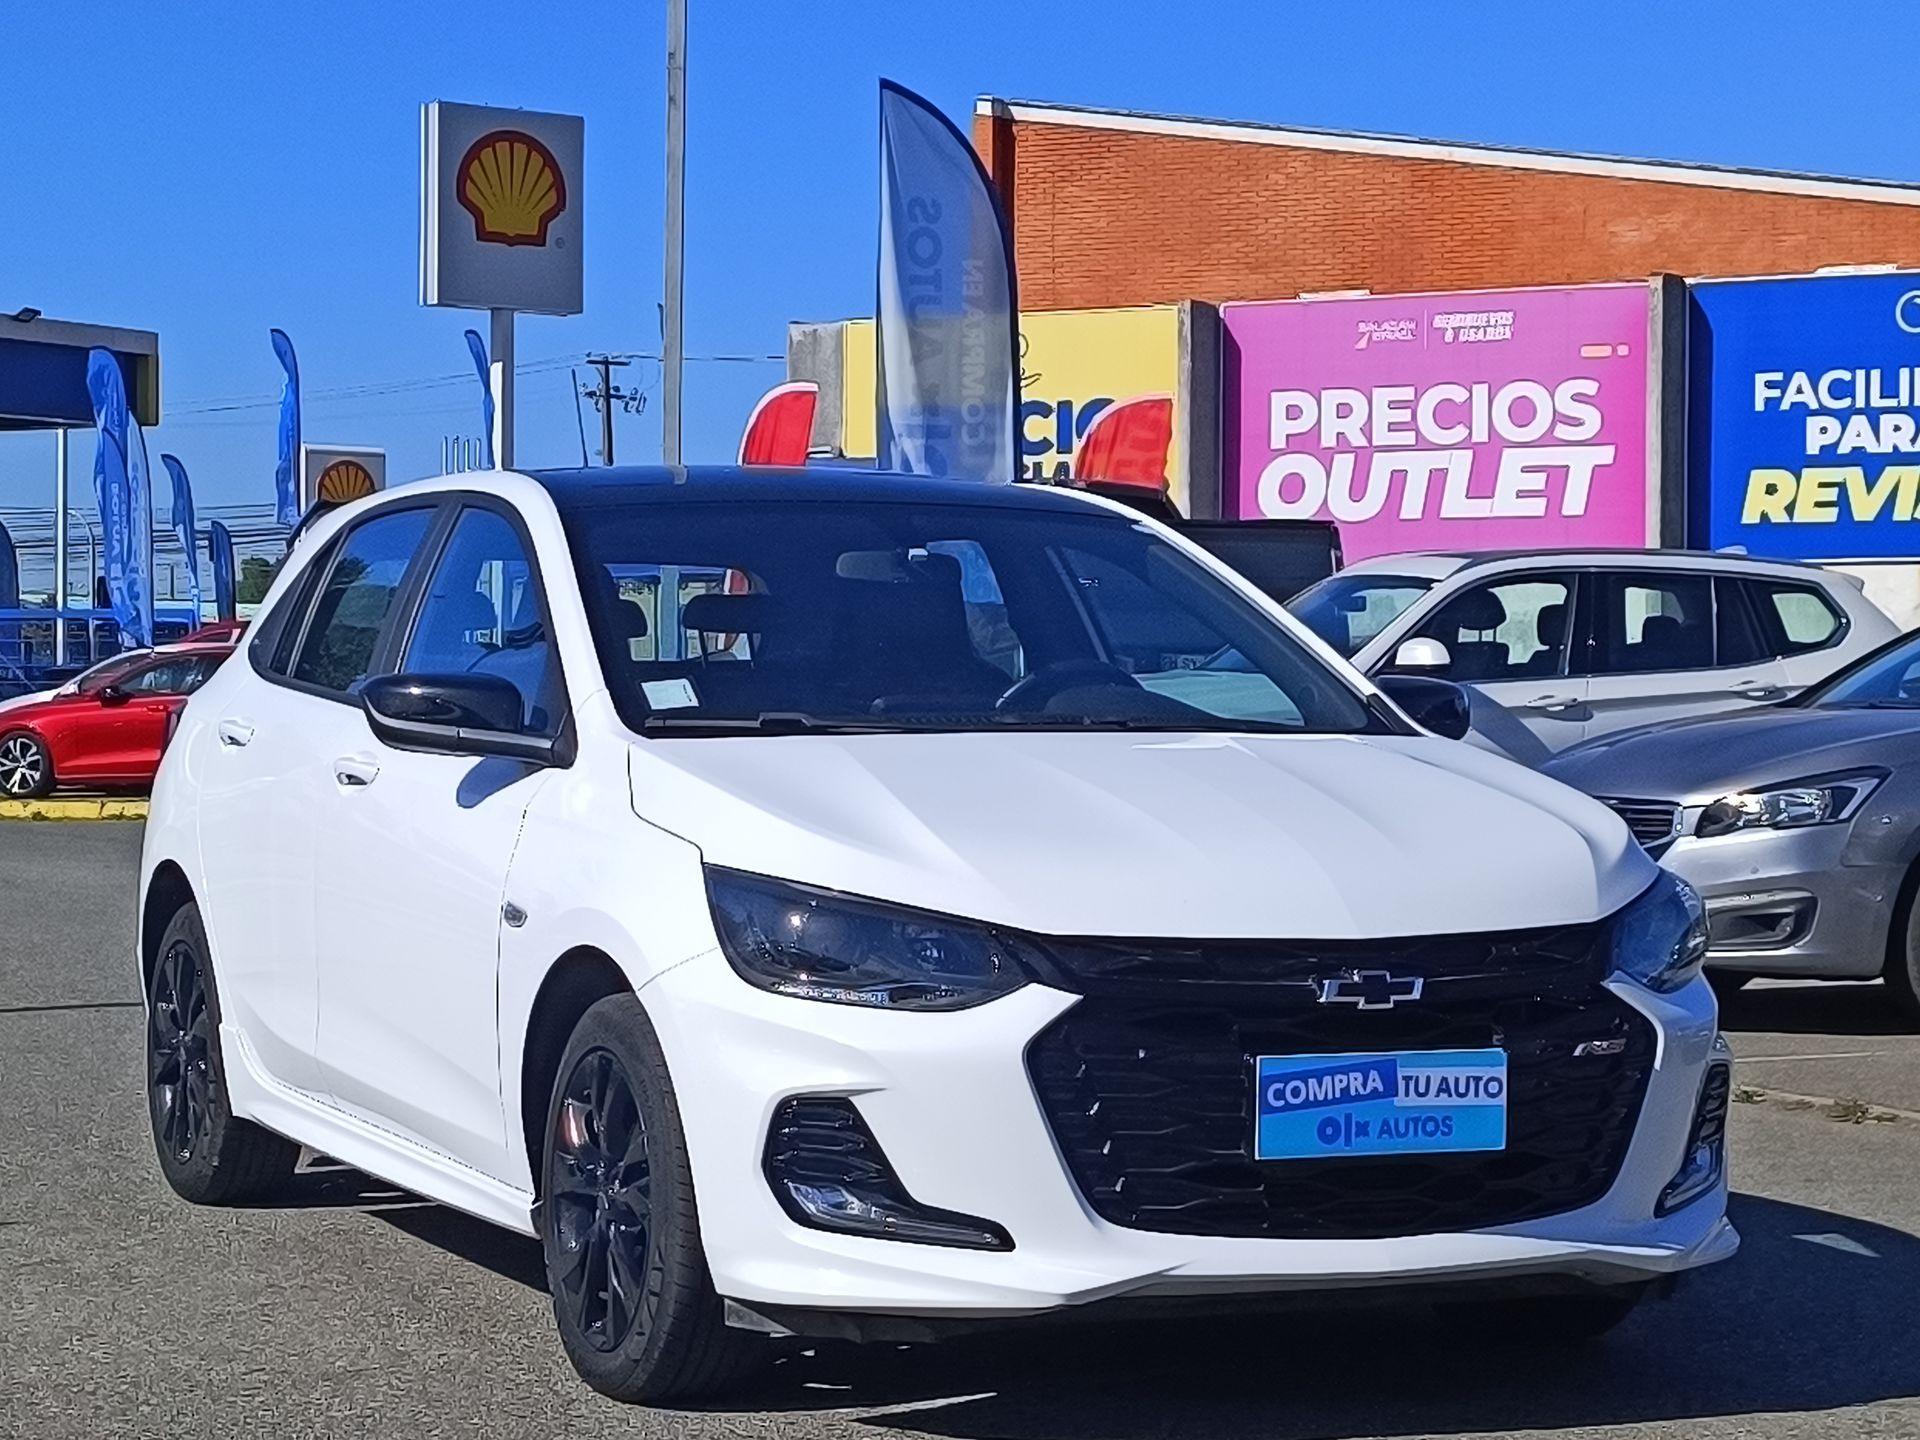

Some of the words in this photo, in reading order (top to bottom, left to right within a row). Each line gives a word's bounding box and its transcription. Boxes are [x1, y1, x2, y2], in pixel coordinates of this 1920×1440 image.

[1269, 378, 1602, 450] PRECIOS
[1755, 367, 1920, 412] FACILI
[1256, 444, 1616, 523] OUTLET
[1740, 465, 1920, 524] REVI
[1267, 1069, 1384, 1107] COMPRA
[1401, 1075, 1431, 1098] TU
[1434, 1074, 1504, 1099] AUTO
[1316, 1112, 1371, 1148] olx
[1376, 1115, 1454, 1141] AUTOS
